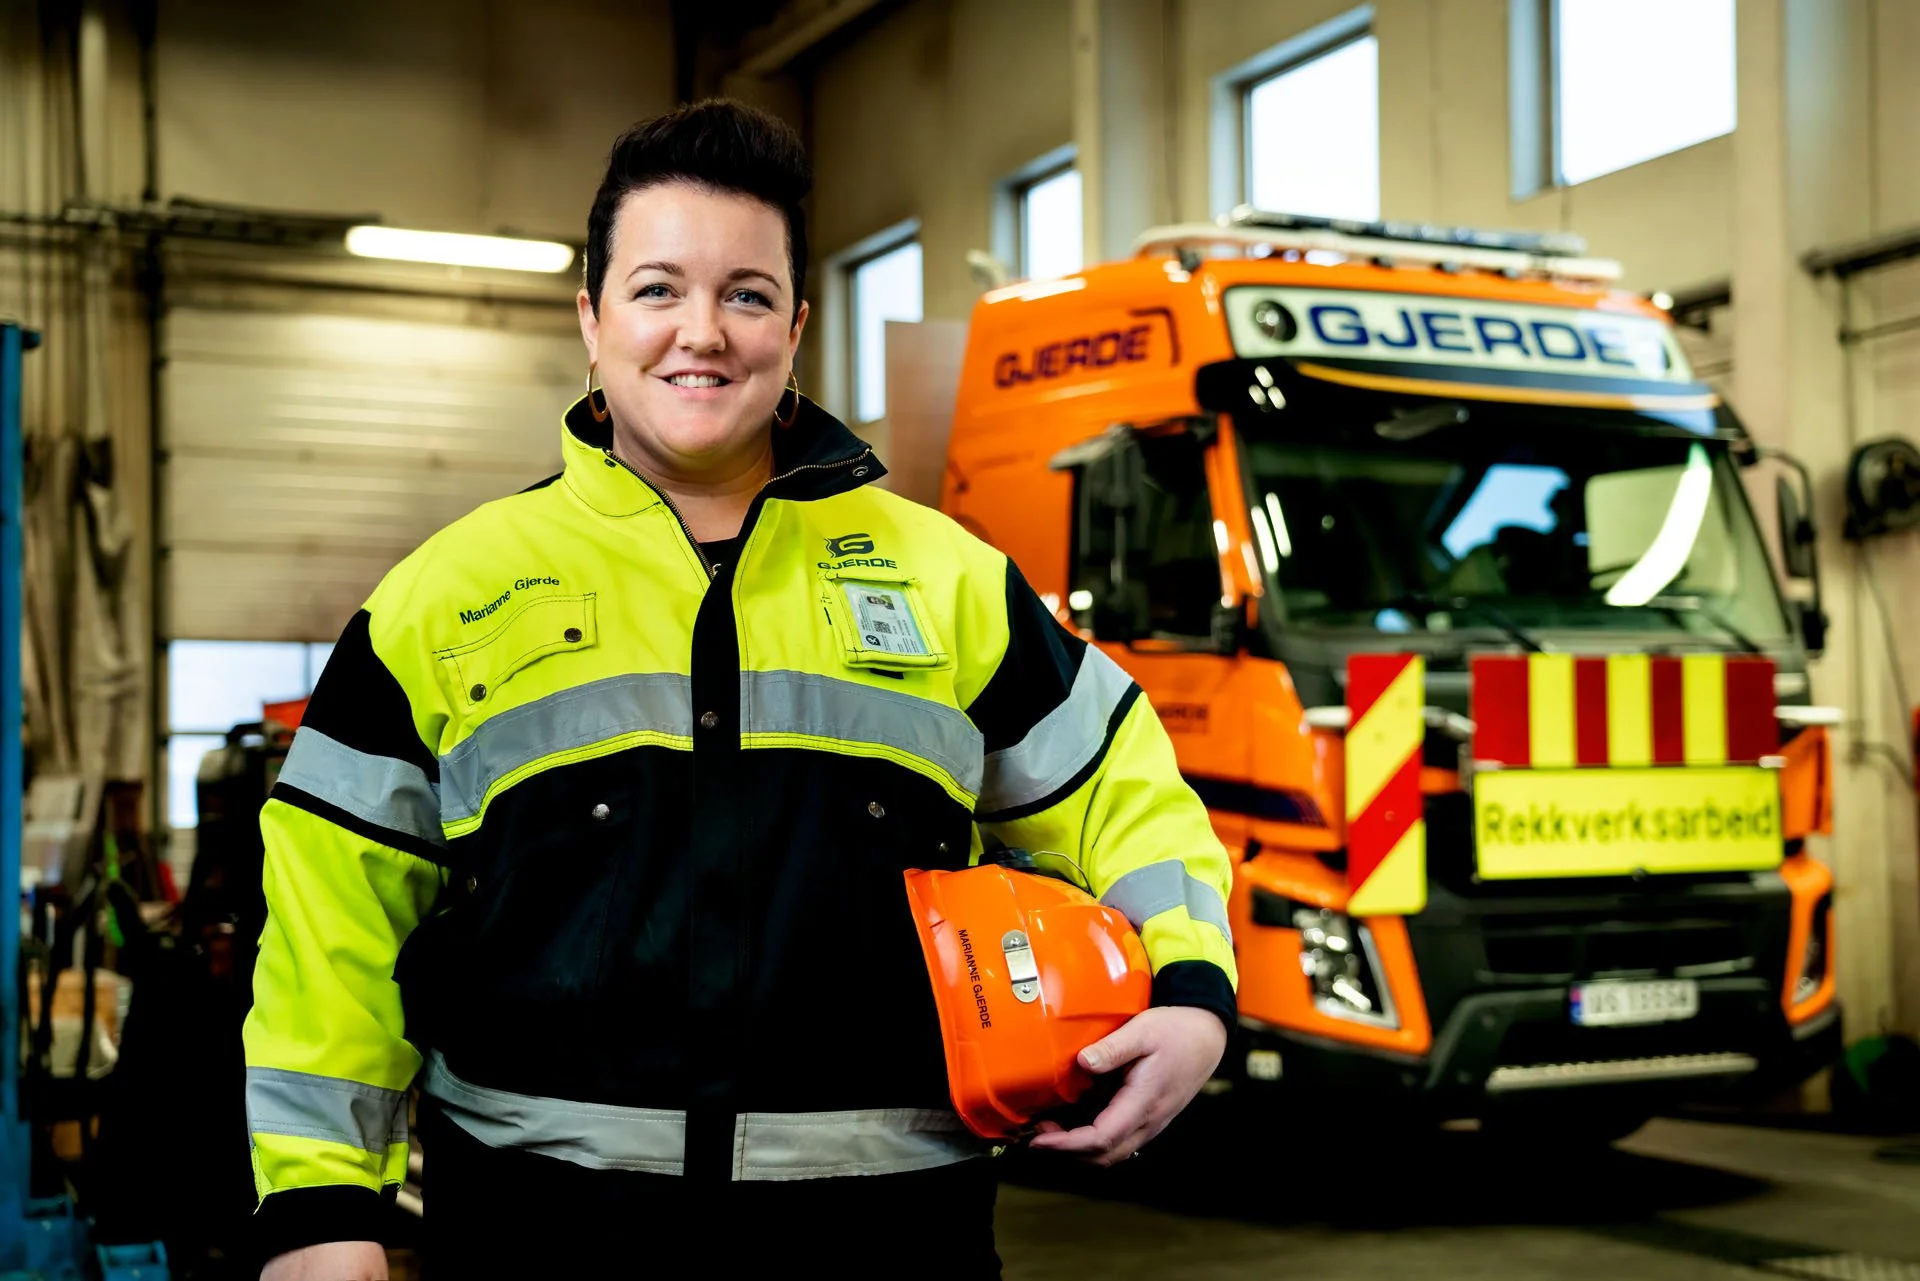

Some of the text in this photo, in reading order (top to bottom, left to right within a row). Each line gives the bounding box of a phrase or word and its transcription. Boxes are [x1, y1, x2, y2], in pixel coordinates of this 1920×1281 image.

[994, 324, 1152, 389] GJERDE
[1308, 304, 1635, 367] GJERDE
[817, 558, 898, 570] GJERDE
[459, 576, 560, 625] Marianne Gjerde
[1481, 798, 1773, 845] Rekkverksarbeid
[957, 929, 992, 1030] MARIANNE GJERDE
